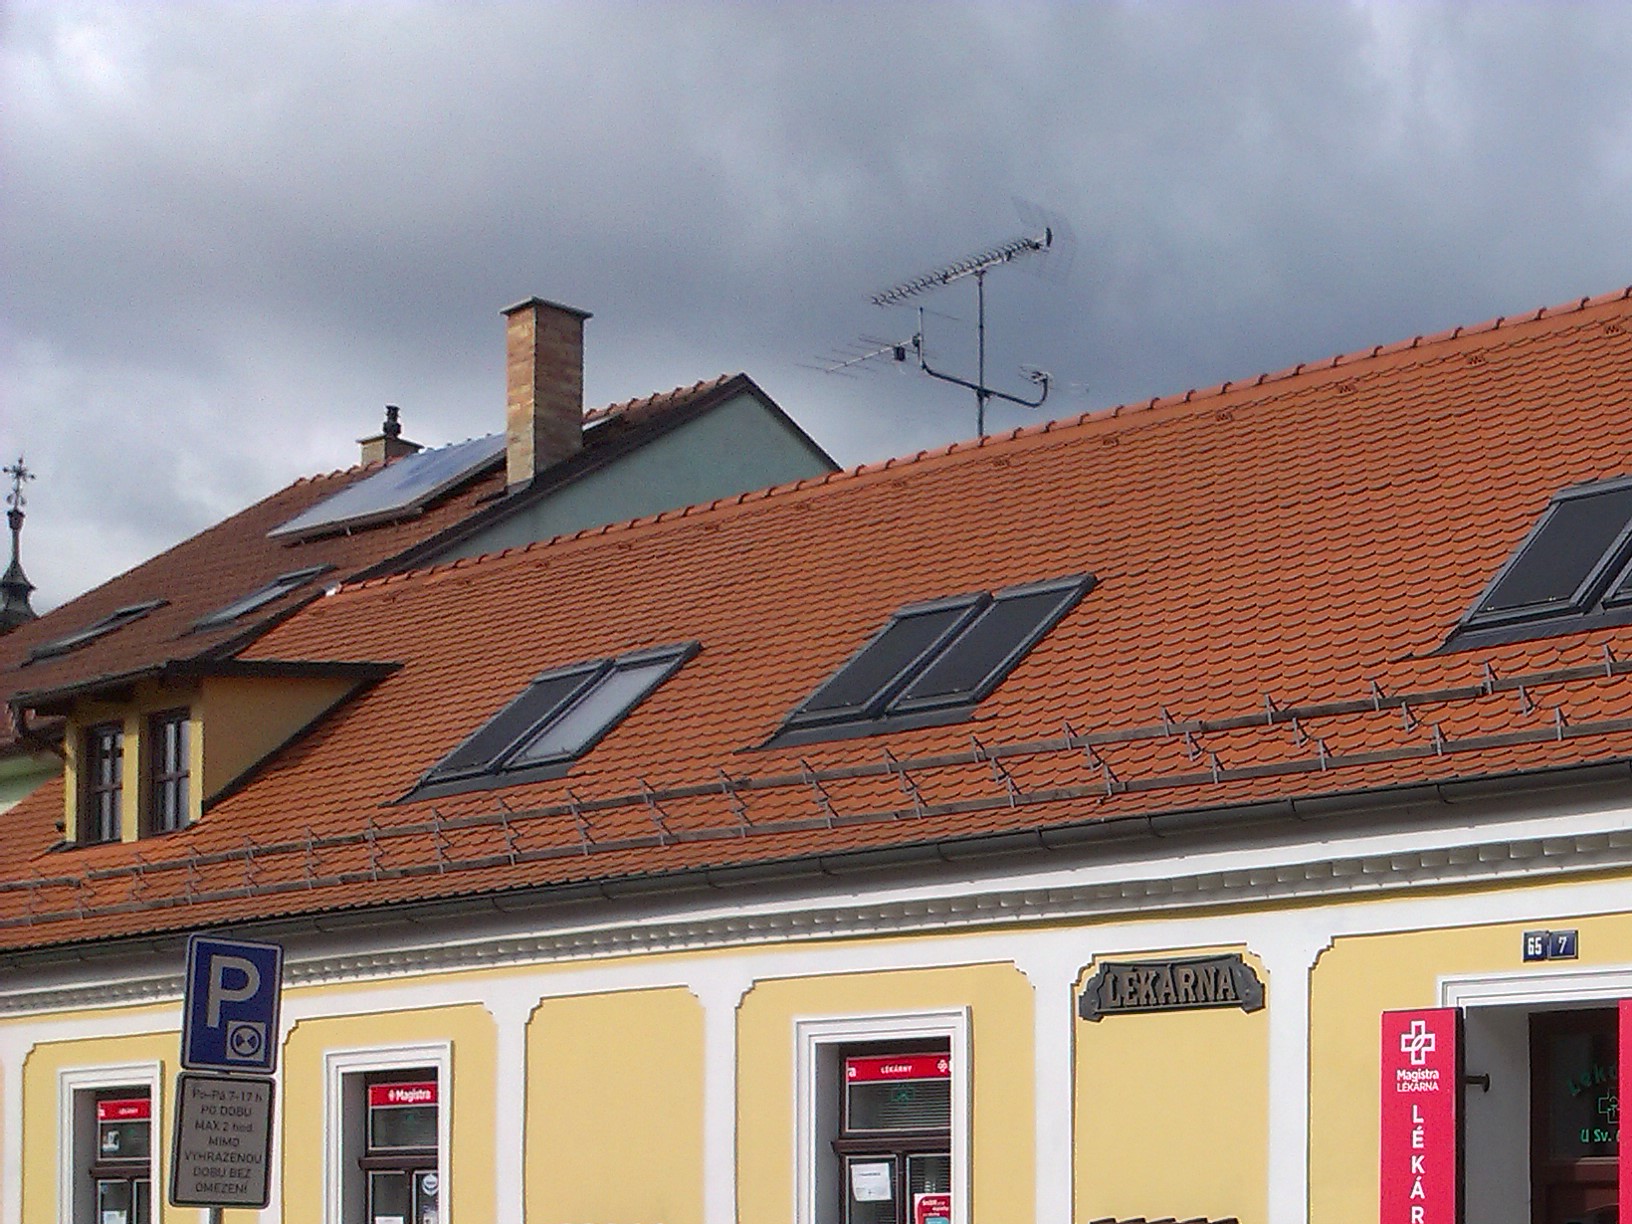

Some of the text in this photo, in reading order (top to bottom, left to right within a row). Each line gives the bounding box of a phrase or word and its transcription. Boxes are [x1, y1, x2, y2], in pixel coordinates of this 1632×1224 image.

[1527, 936, 1567, 955] 65 7
[206, 954, 261, 1028] P
[1396, 1068, 1440, 1082] Magistra
[1396, 1080, 1439, 1092] LÉKÁRNA
[395, 1088, 432, 1103] Magistra
[201, 1104, 252, 1117] PO DOBU
[195, 1120, 220, 1132] MAX
[208, 1135, 240, 1148] MIMO
[1580, 1128, 1590, 1143] U
[184, 1149, 263, 1164] VYHRAZENOU
[193, 1166, 252, 1179] DOBU BEZ
